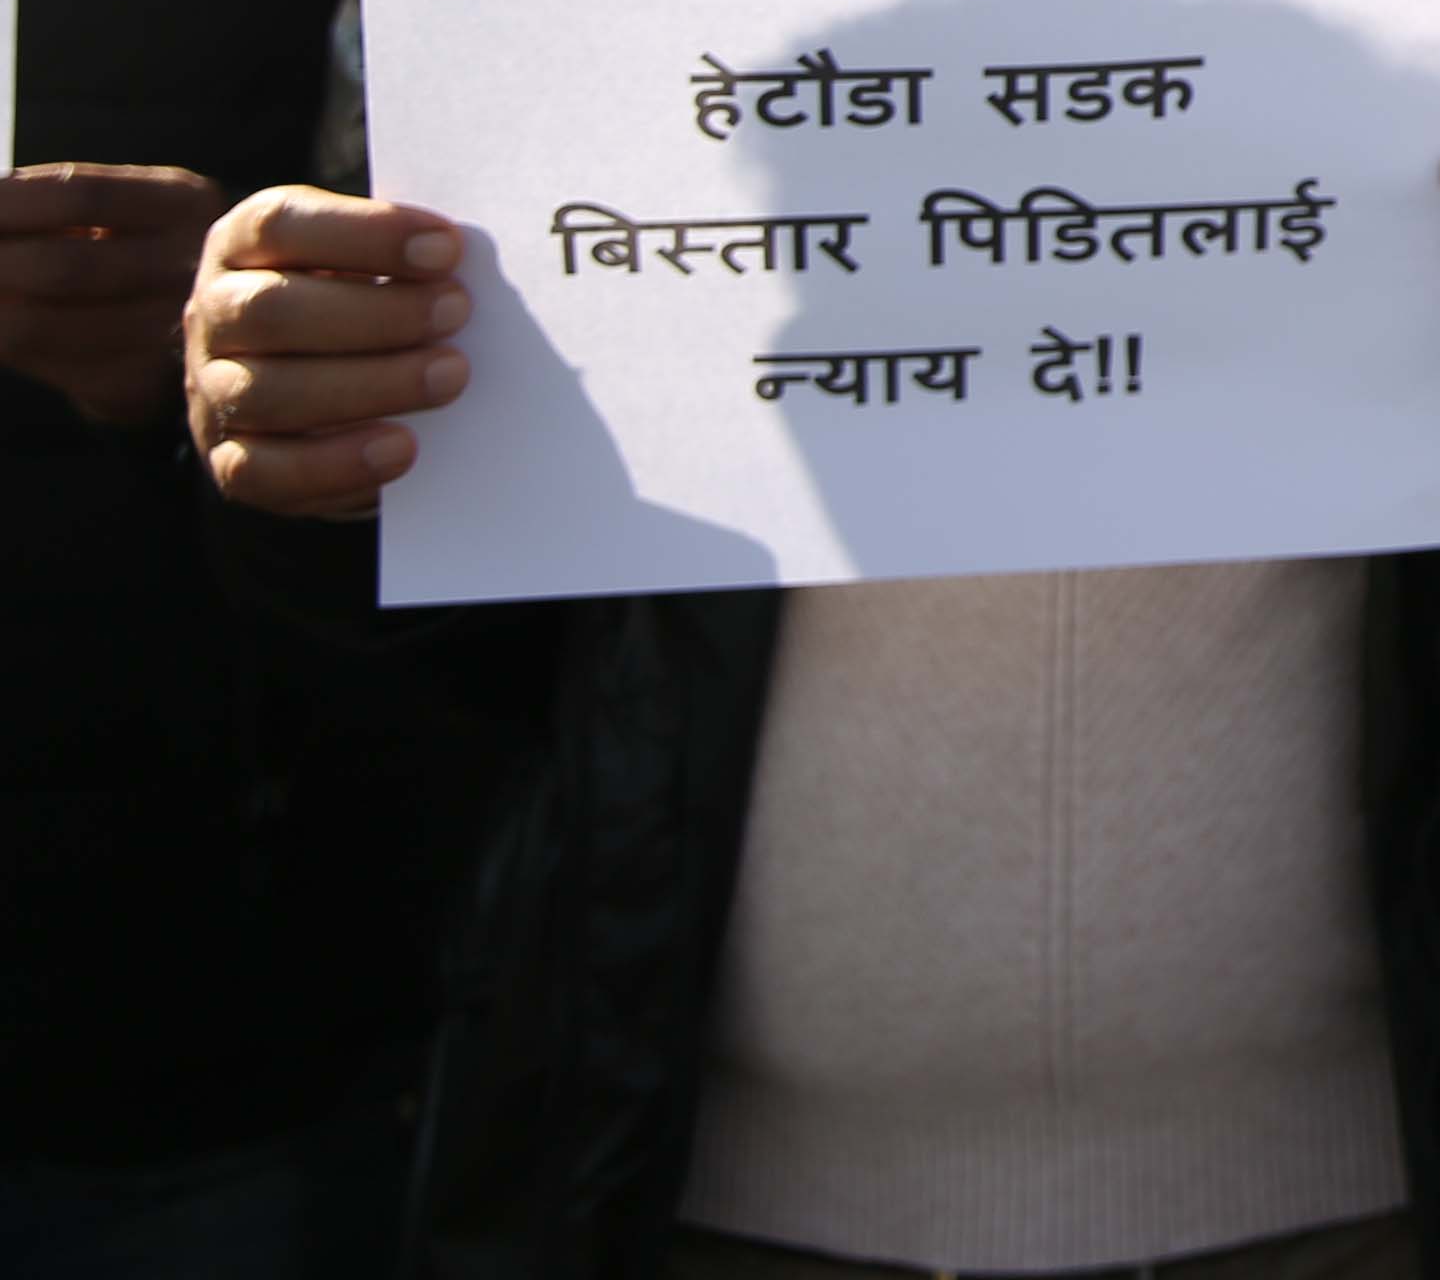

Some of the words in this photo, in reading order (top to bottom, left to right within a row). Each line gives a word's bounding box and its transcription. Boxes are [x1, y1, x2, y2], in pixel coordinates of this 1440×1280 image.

[688, 46, 934, 142] हेटौडा
[981, 55, 1205, 127] सडक
[549, 201, 870, 277] बिस्तार
[917, 176, 1338, 268] पिडितलाई
[751, 345, 983, 407] न्याय
[1028, 325, 1144, 404] दे!!
